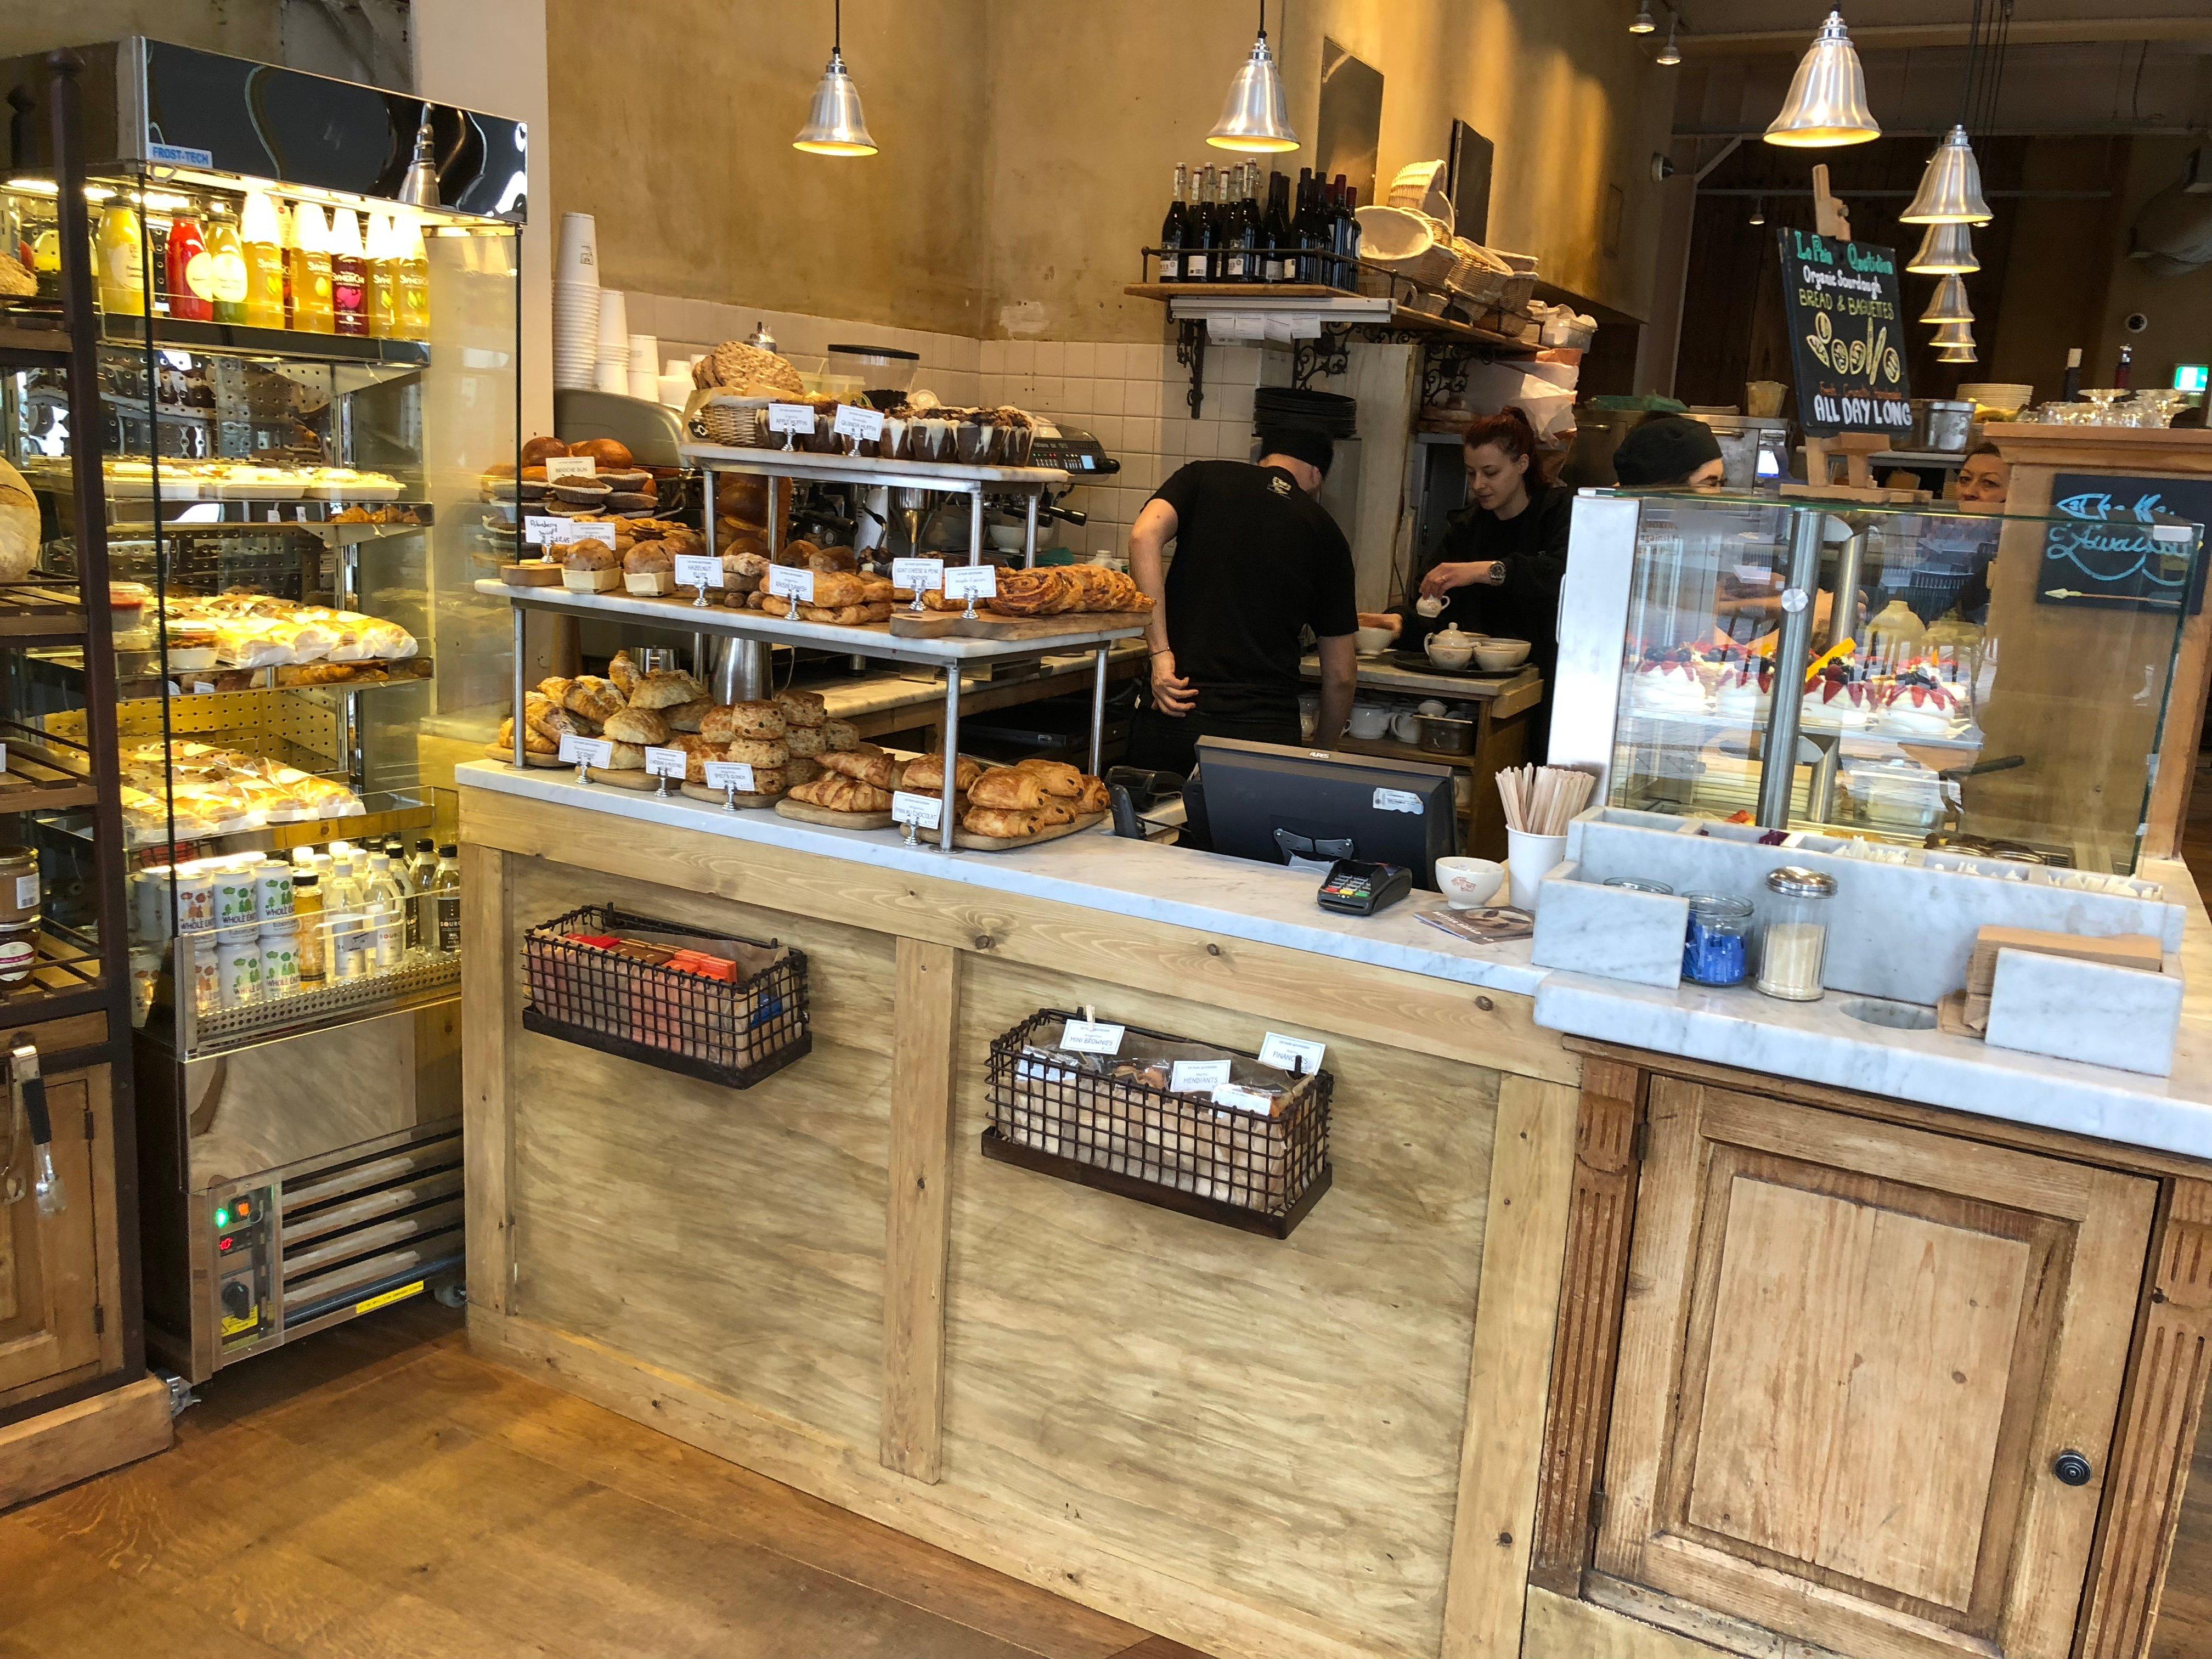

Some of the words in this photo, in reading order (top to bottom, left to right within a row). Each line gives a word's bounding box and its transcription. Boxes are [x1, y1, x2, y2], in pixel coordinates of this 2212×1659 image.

[153, 146, 208, 165] FROST-TECH
[1798, 288, 1833, 311] BREAD
[1837, 295, 1846, 312] &
[1814, 394, 1841, 423] ALL
[1841, 397, 1871, 425] DAY
[1873, 399, 1912, 426] LONG
[913, 810, 937, 820] CHOCOLAT
[265, 907, 287, 916] WHOLE
[222, 915, 245, 924] WHOLE
[1084, 1037, 1113, 1046] BROWNIES
